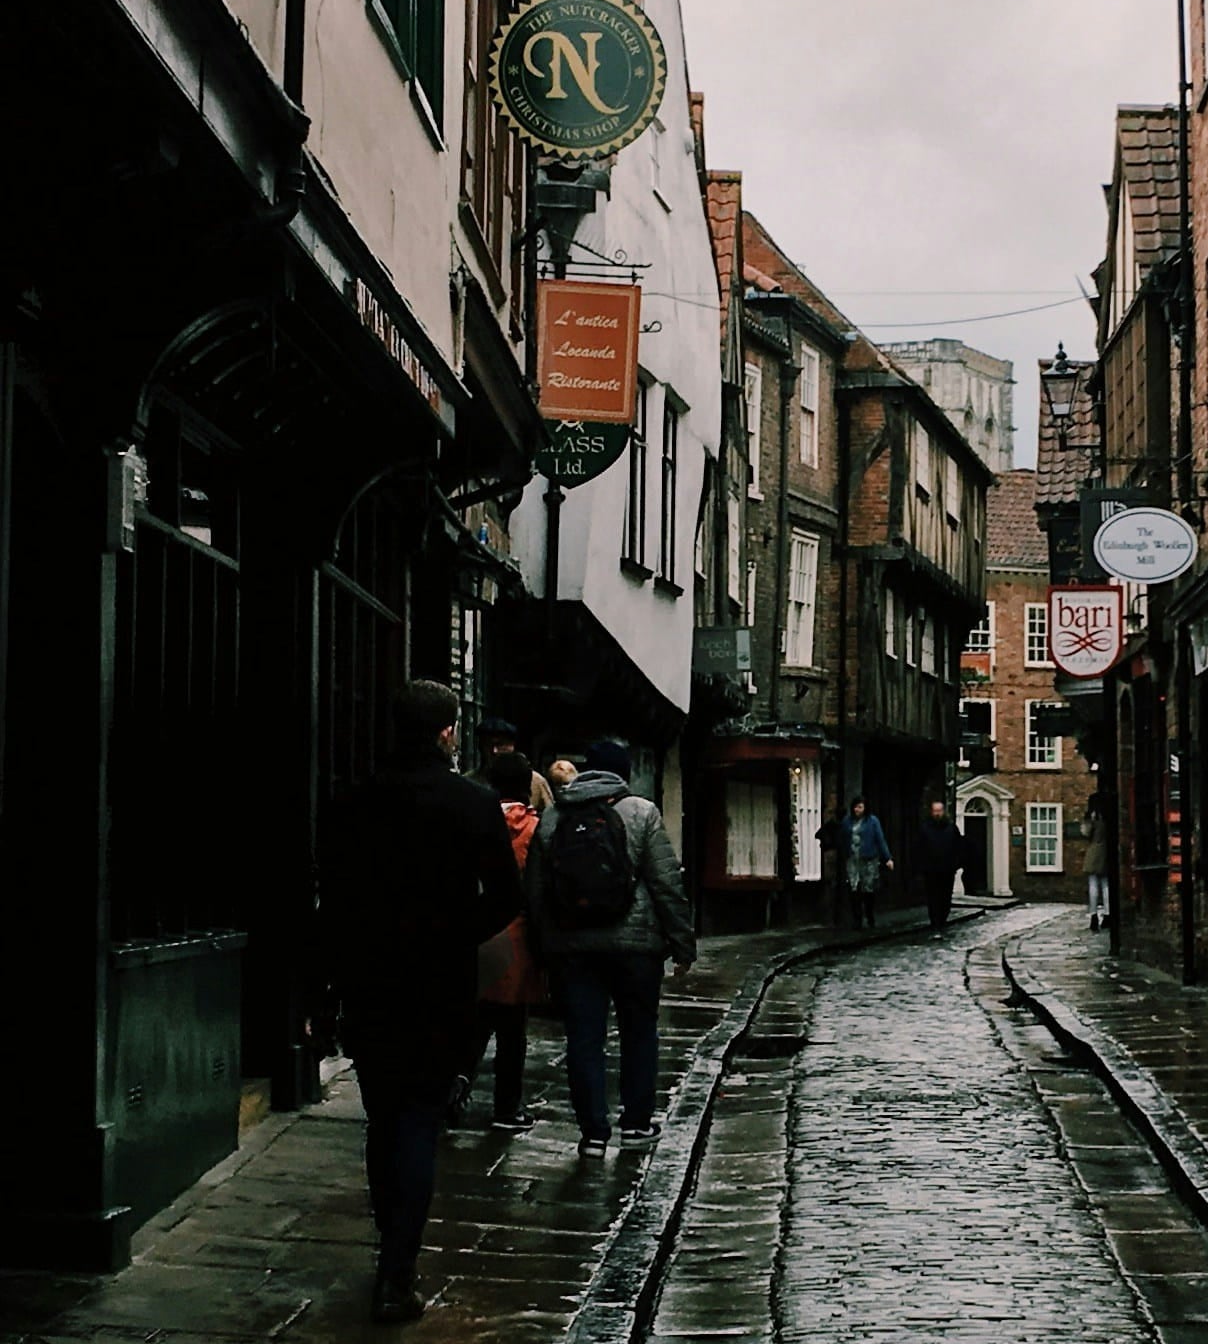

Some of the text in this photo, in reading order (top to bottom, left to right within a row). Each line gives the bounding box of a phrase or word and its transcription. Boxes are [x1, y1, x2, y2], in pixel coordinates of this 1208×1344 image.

[526, 4, 641, 56] THE NUTCRACKER
[523, 30, 629, 115] N
[510, 85, 621, 140] CHRISTMAS SHOP
[552, 340, 616, 359] Locanda
[547, 371, 621, 392] Ristorante
[554, 458, 586, 475] Ltd.
[1057, 596, 1113, 629] bari
